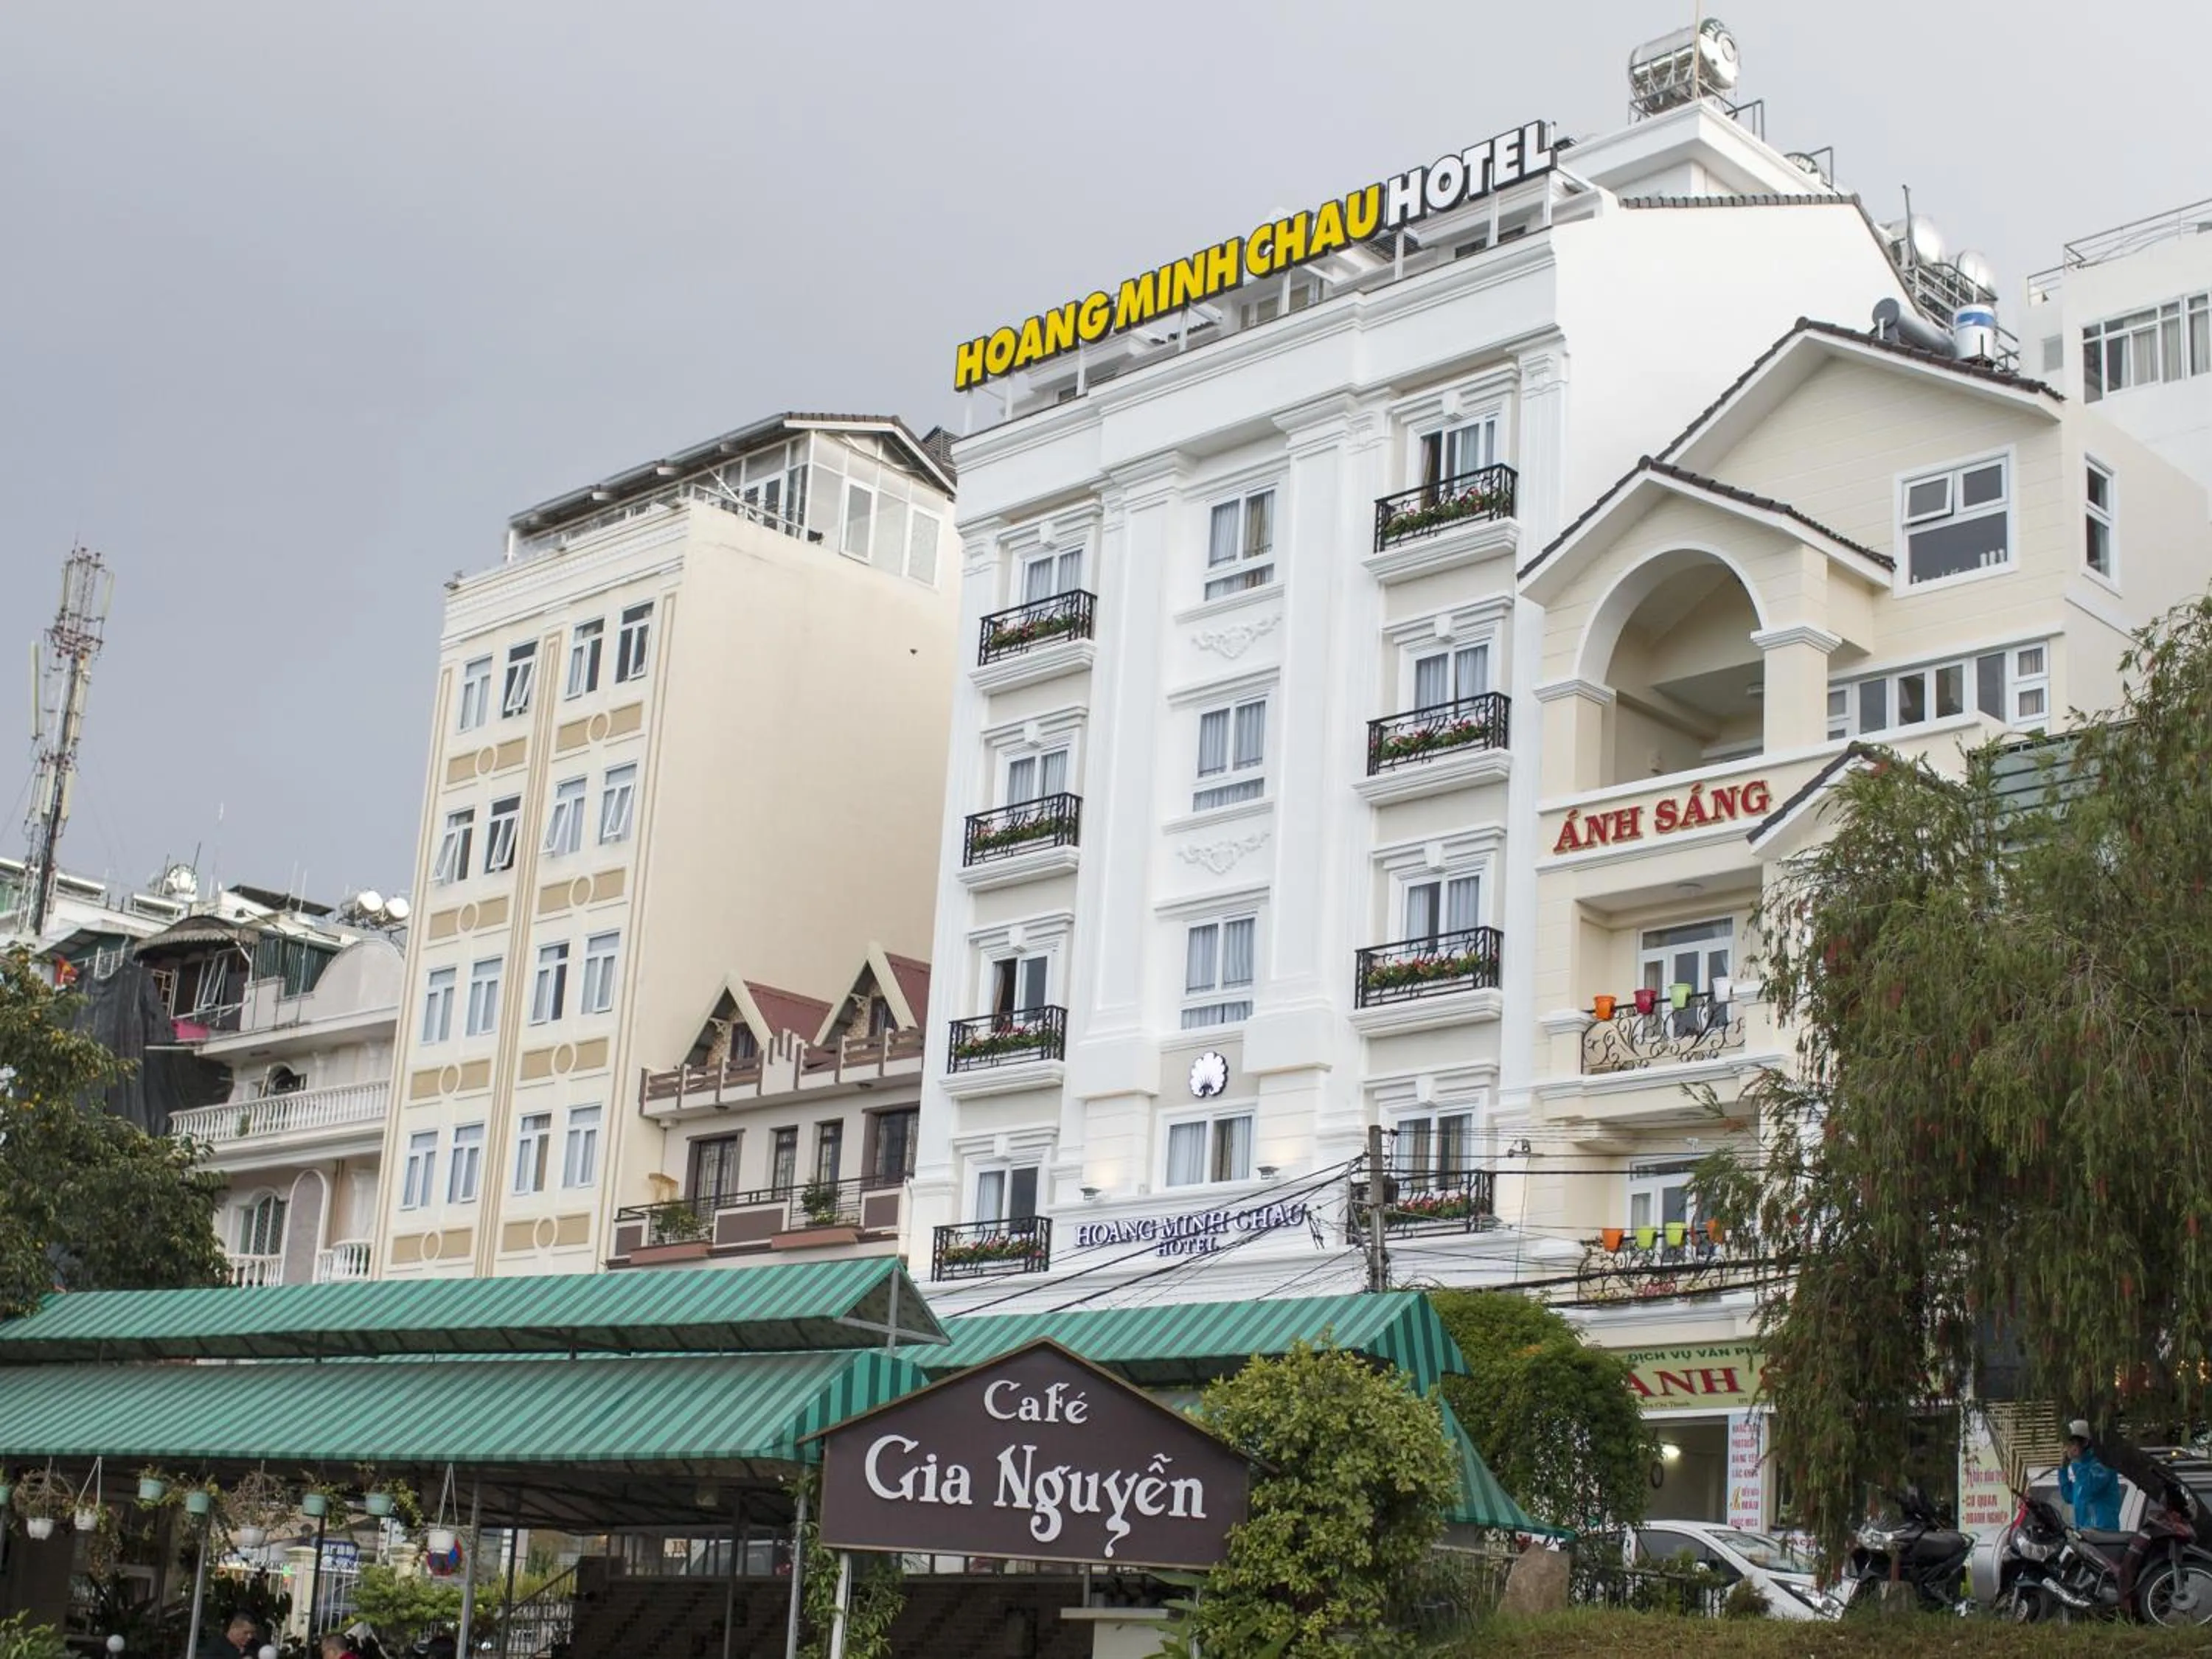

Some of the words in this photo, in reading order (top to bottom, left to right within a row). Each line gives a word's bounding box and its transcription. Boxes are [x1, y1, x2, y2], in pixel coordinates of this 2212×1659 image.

[954, 292, 1115, 393] HOANG
[1113, 235, 1244, 331] MINH
[1244, 183, 1385, 278] CHAU
[1385, 119, 1557, 228] HOTEL
[1553, 806, 1644, 854] ÁNH
[1654, 781, 1770, 833] SÁNG
[1076, 1220, 1156, 1248] HOANG
[1160, 1211, 1229, 1239] MINH
[1234, 1203, 1307, 1231] CHAU
[1156, 1237, 1220, 1256] HOTEL
[1627, 1350, 1666, 1363] DỊCH
[1669, 1350, 1692, 1360] VỤ
[984, 1380, 1088, 1425] Café
[865, 1435, 973, 1506] Gia
[993, 1444, 1207, 1558] Nguyễn
